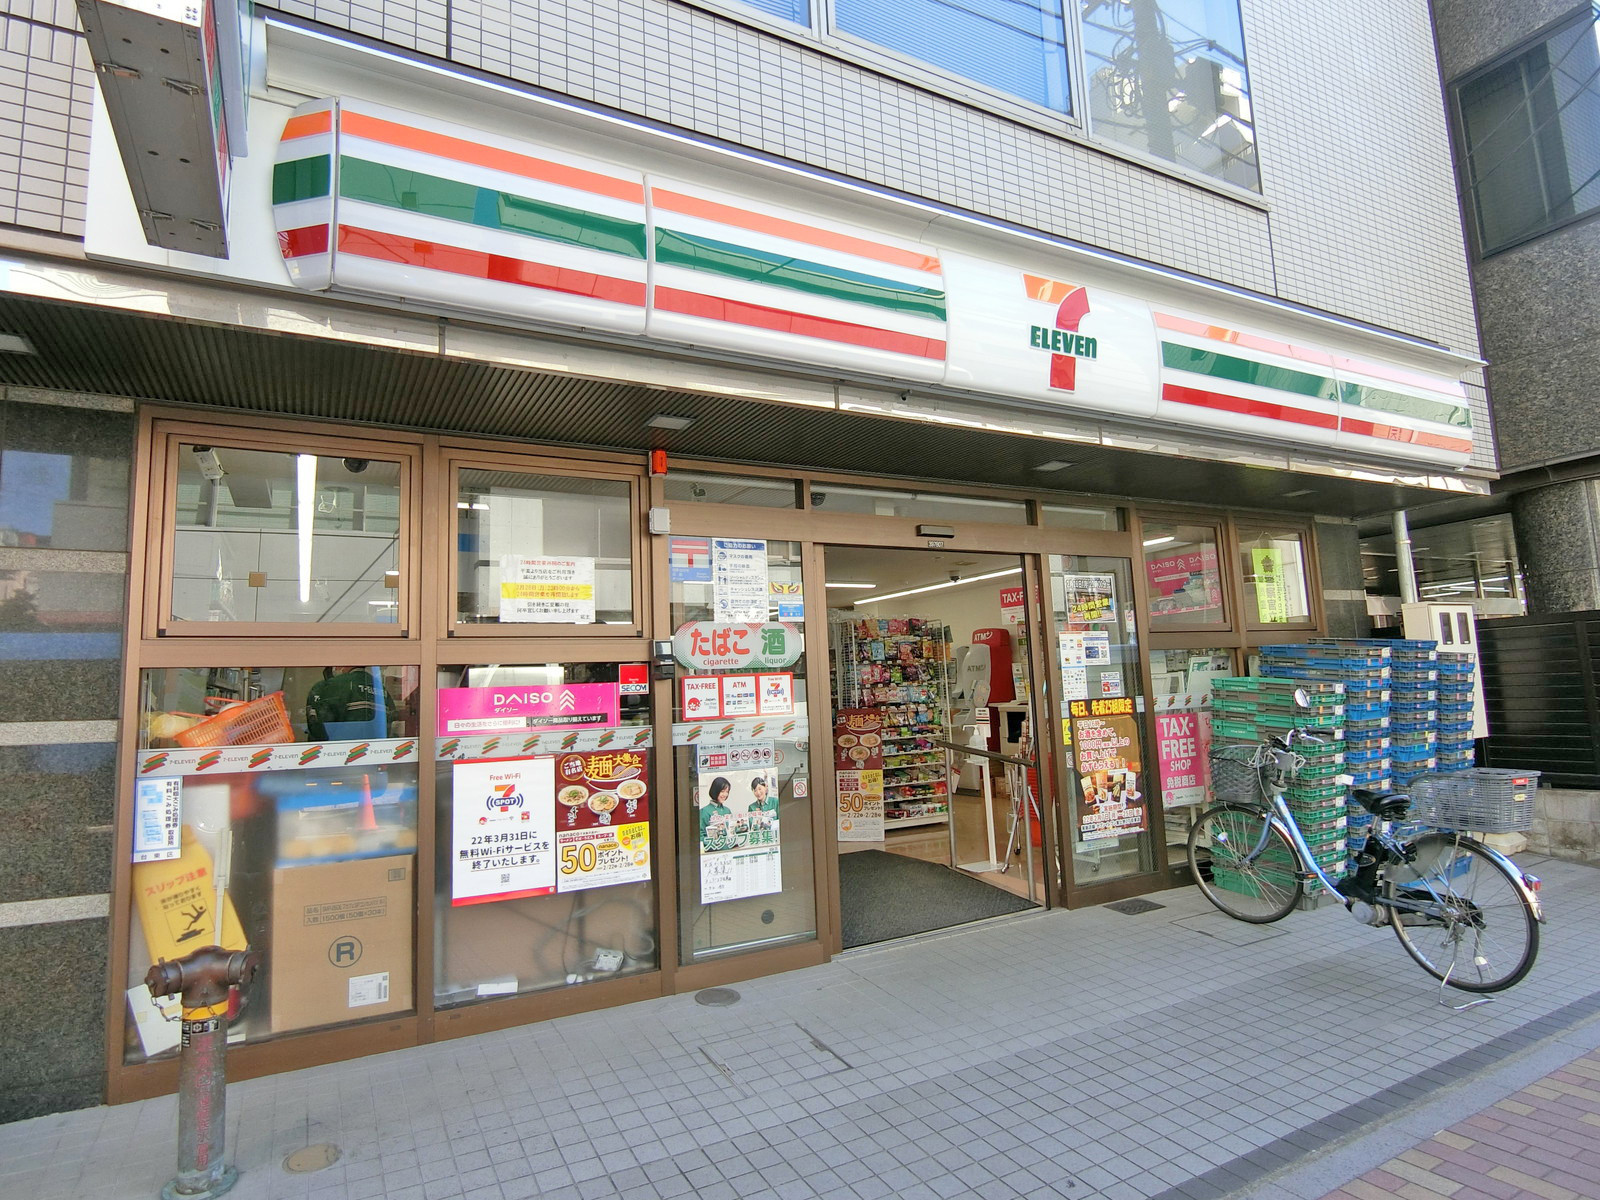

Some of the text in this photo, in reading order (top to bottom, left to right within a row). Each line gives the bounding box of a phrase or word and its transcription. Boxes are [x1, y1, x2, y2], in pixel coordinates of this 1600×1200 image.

[1030, 325, 1097, 358] ELEVEN
[1150, 560, 1176, 570] DAISO
[1188, 553, 1217, 564] DAISO
[690, 627, 786, 657] たばこ 酒
[702, 657, 787, 667] cigarette liquor
[621, 684, 647, 692] SECOM
[686, 682, 717, 690] TAX-FREE
[732, 681, 747, 689] ATM
[493, 691, 553, 706] DAISO
[1160, 716, 1194, 738] TAX-
[1161, 737, 1197, 760] FREE
[1170, 758, 1192, 772] SHOP
[504, 772, 521, 780] Wi-Fi
[495, 797, 515, 806] SPOT
[839, 793, 863, 812] 50
[471, 830, 538, 845] 22年3月31日に
[704, 829, 778, 849] スタッフ募集!
[141, 851, 174, 860] 台東区
[459, 841, 550, 859] 無料Wi-Fiサービスを
[597, 849, 624, 858] ポイント
[472, 854, 541, 870] 終了いたします。
[561, 842, 597, 875] 50
[597, 856, 629, 866] プレゼント!
[145, 867, 208, 897] スリップ注意
[335, 941, 355, 962] R
